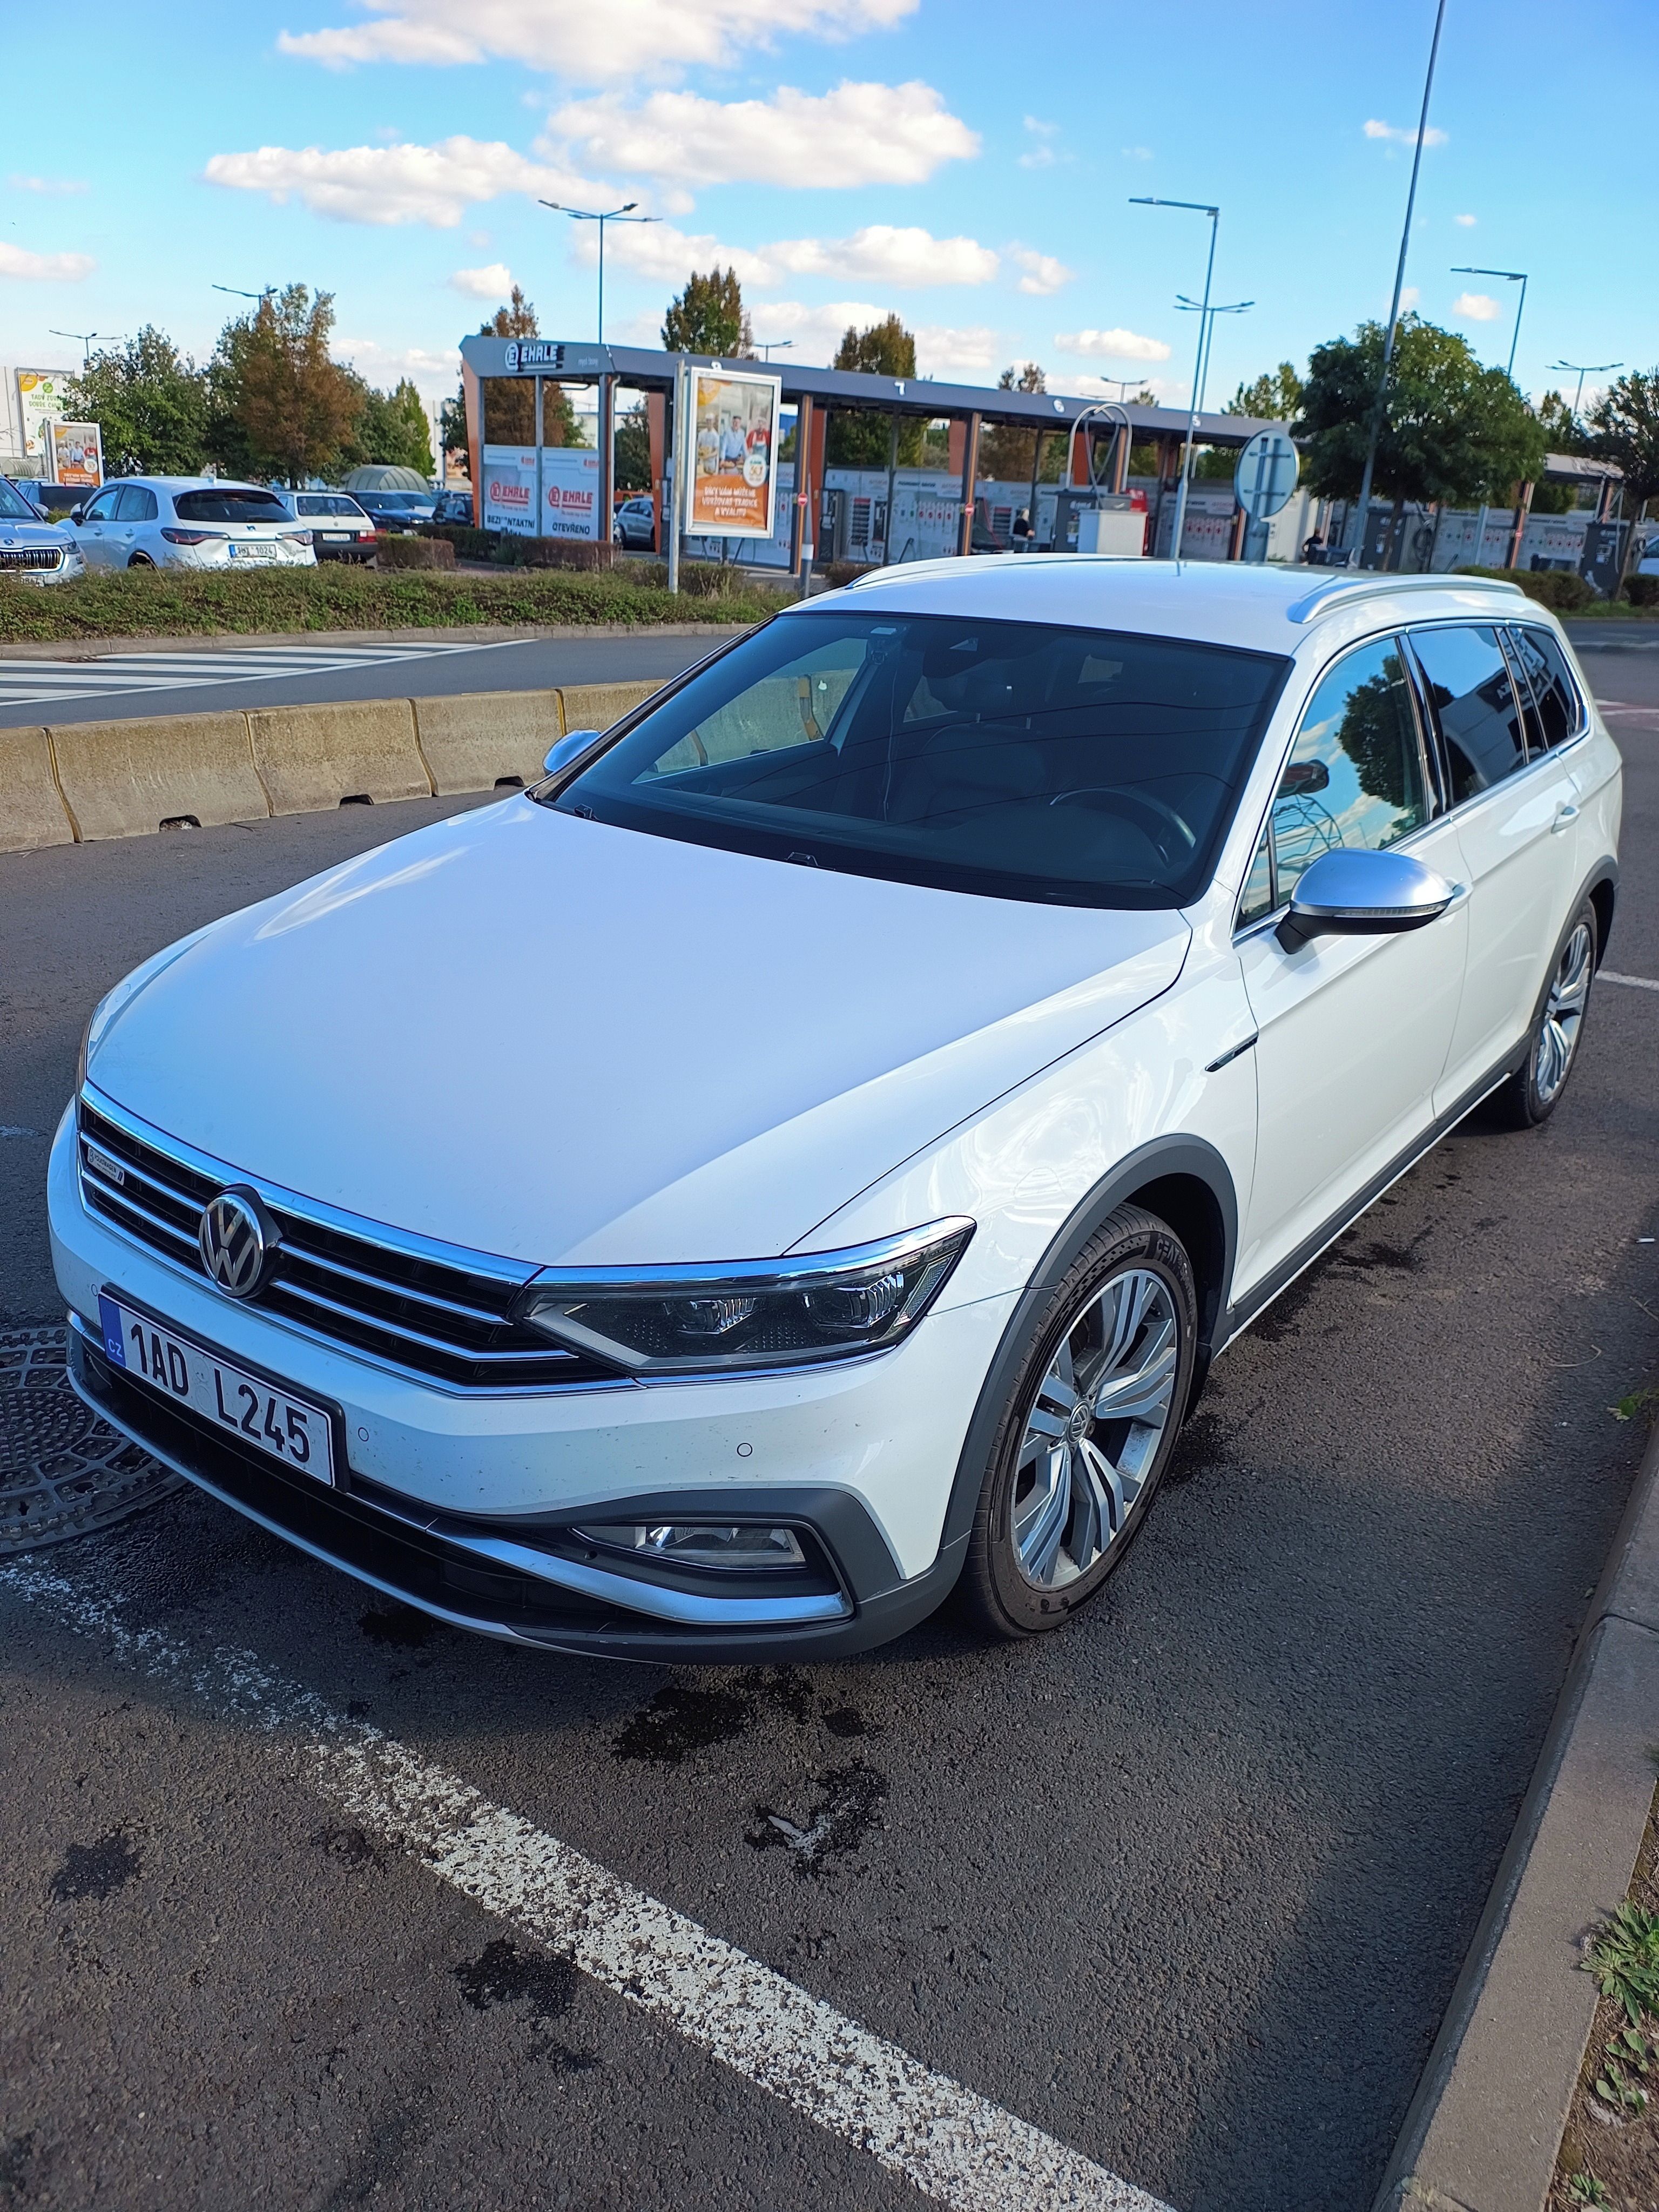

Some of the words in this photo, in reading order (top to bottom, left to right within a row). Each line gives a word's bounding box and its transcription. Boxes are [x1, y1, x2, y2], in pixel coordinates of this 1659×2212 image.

[521, 345, 558, 363] EHRLE
[894, 380, 905, 395] 7
[502, 485, 530, 500] EHRLE
[562, 490, 593, 504] EHRLE
[487, 514, 535, 529] BEZNTAKTNÍ
[552, 521, 590, 535] OTEVŘENO
[108, 1338, 123, 1358] CZ
[131, 1323, 189, 1397] 1AD
[215, 1367, 310, 1463] L245
